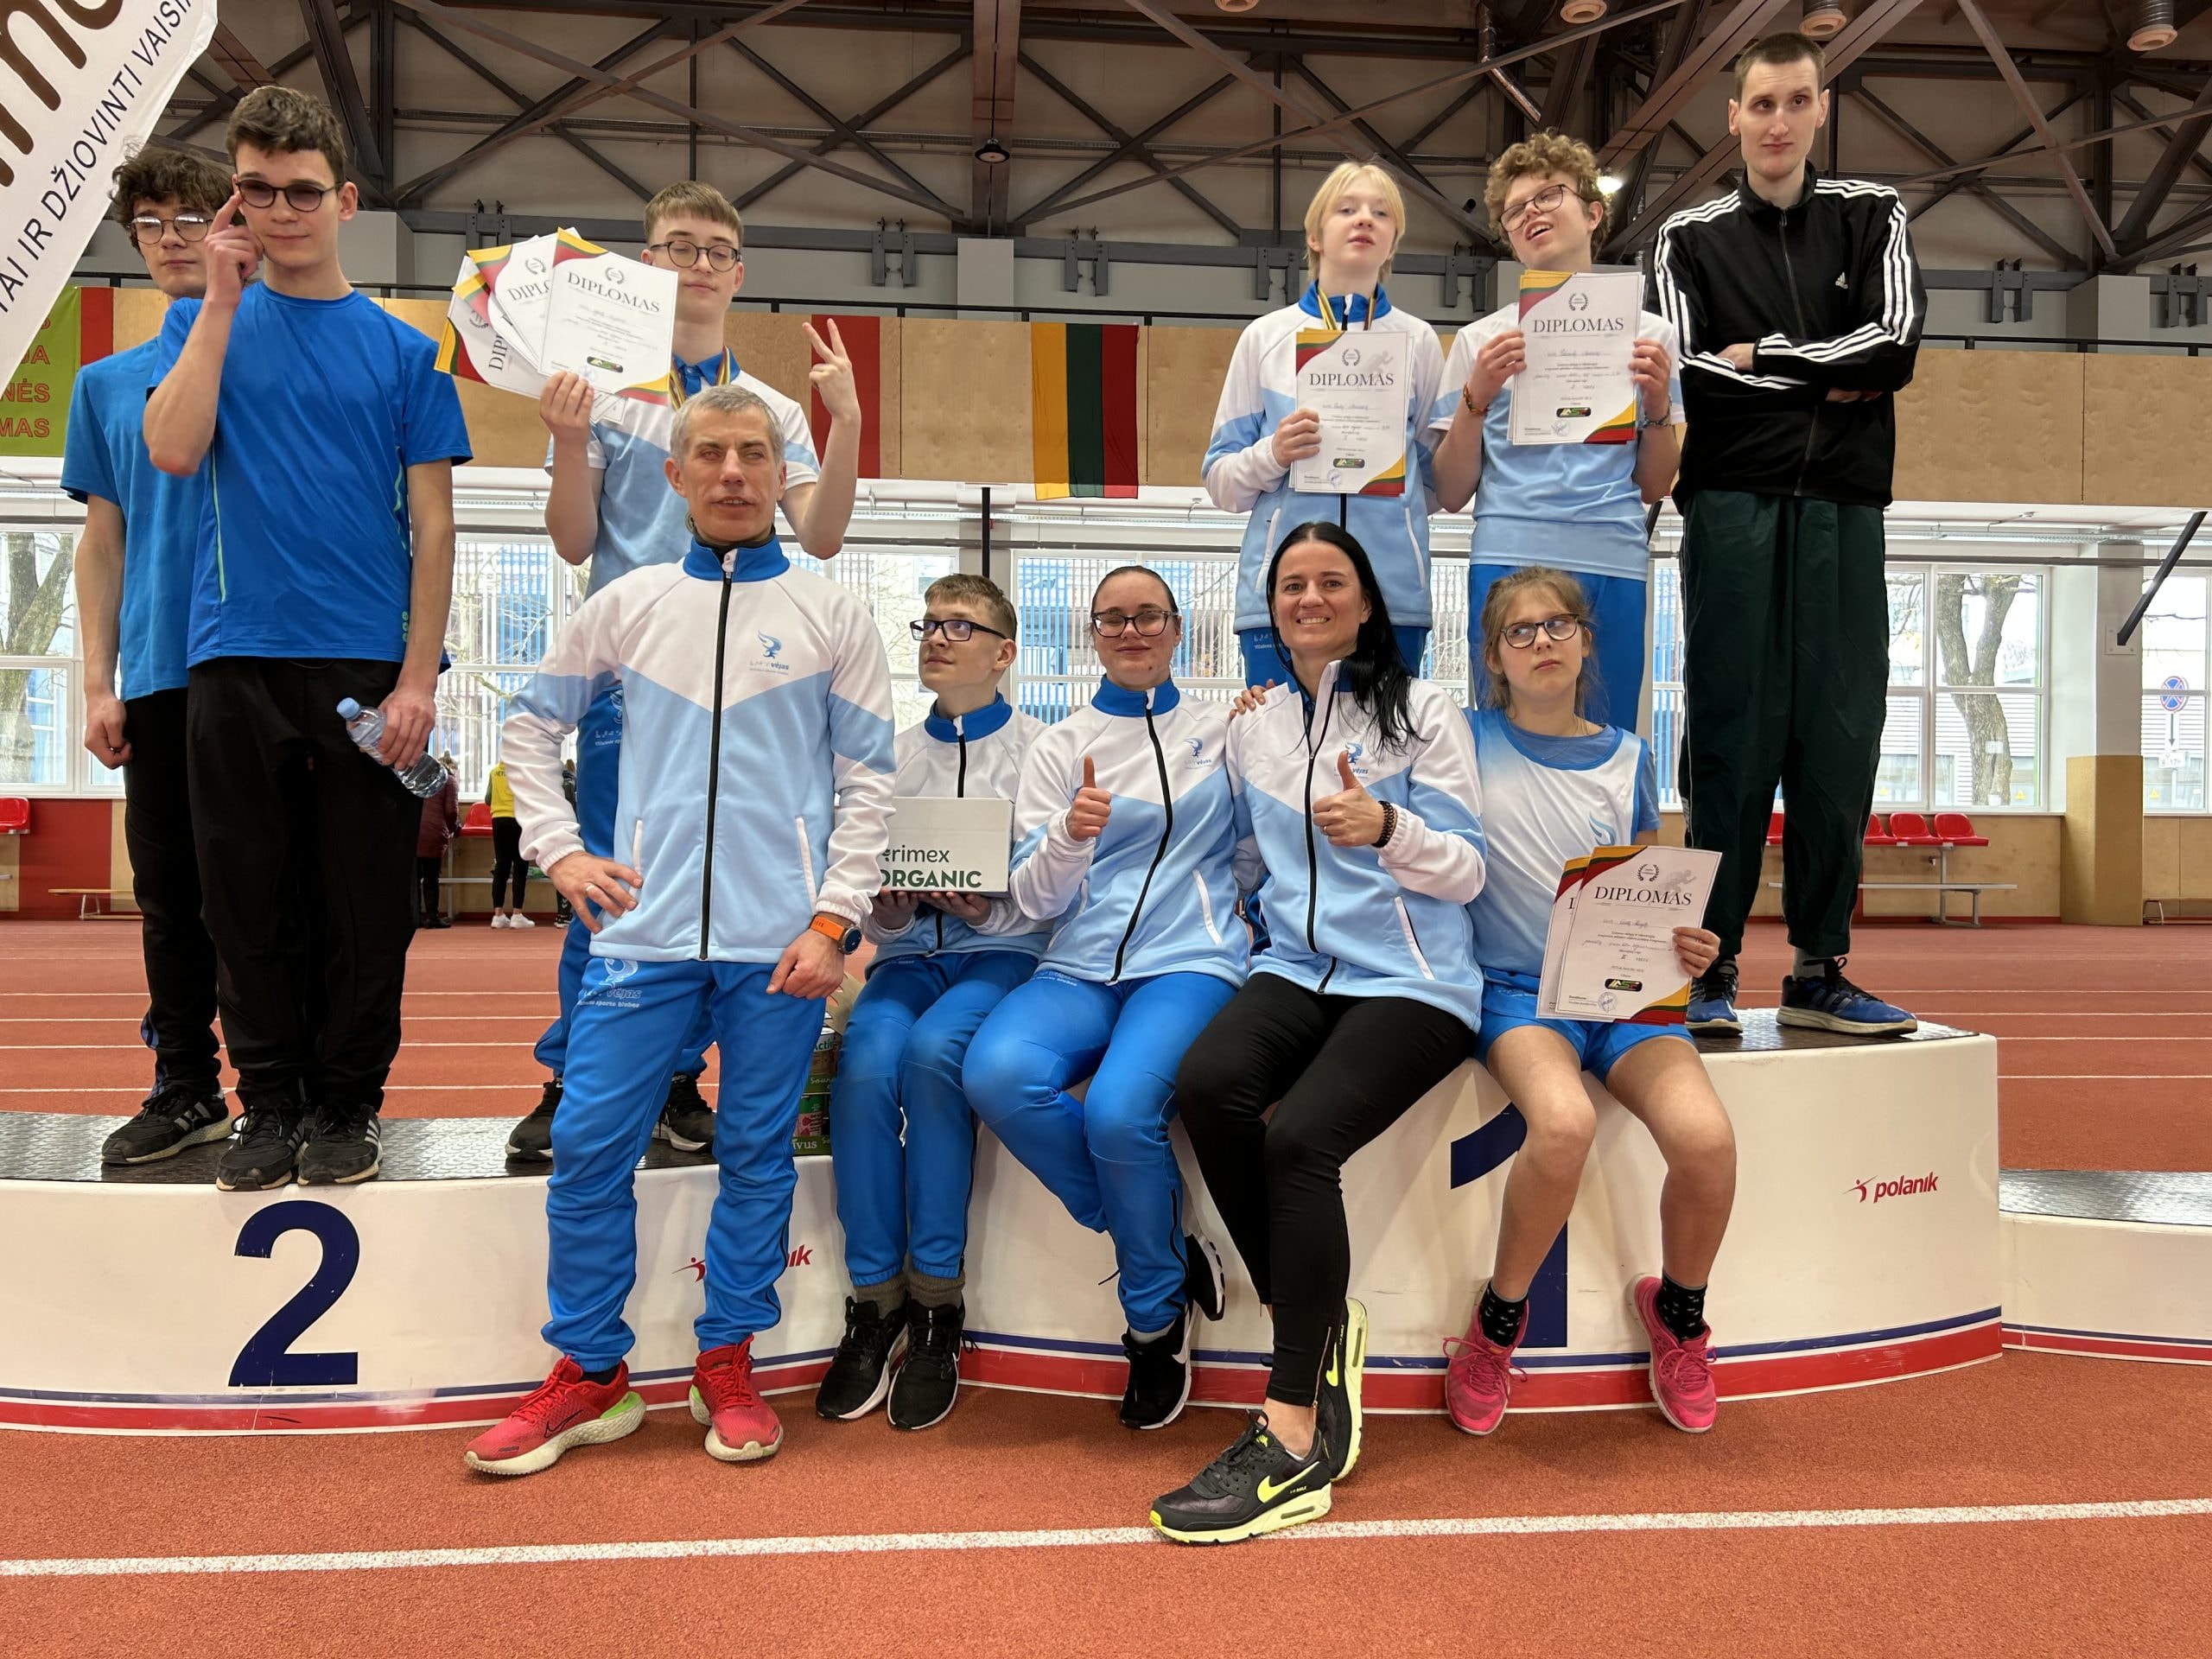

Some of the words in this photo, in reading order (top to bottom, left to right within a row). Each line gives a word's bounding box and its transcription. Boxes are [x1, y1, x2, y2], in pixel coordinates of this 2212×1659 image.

[17, 218, 54, 261] IR
[40, 63, 143, 222] DŽIOVINTI
[567, 271, 661, 314] DIPLOMAS
[1533, 317, 1625, 334] DIPLOMAS
[1309, 372, 1395, 387] DIPLOMAS
[1594, 886, 1693, 906] DIPLOMAS
[1872, 1171, 1939, 1205] polanik
[227, 1199, 360, 1387] 2
